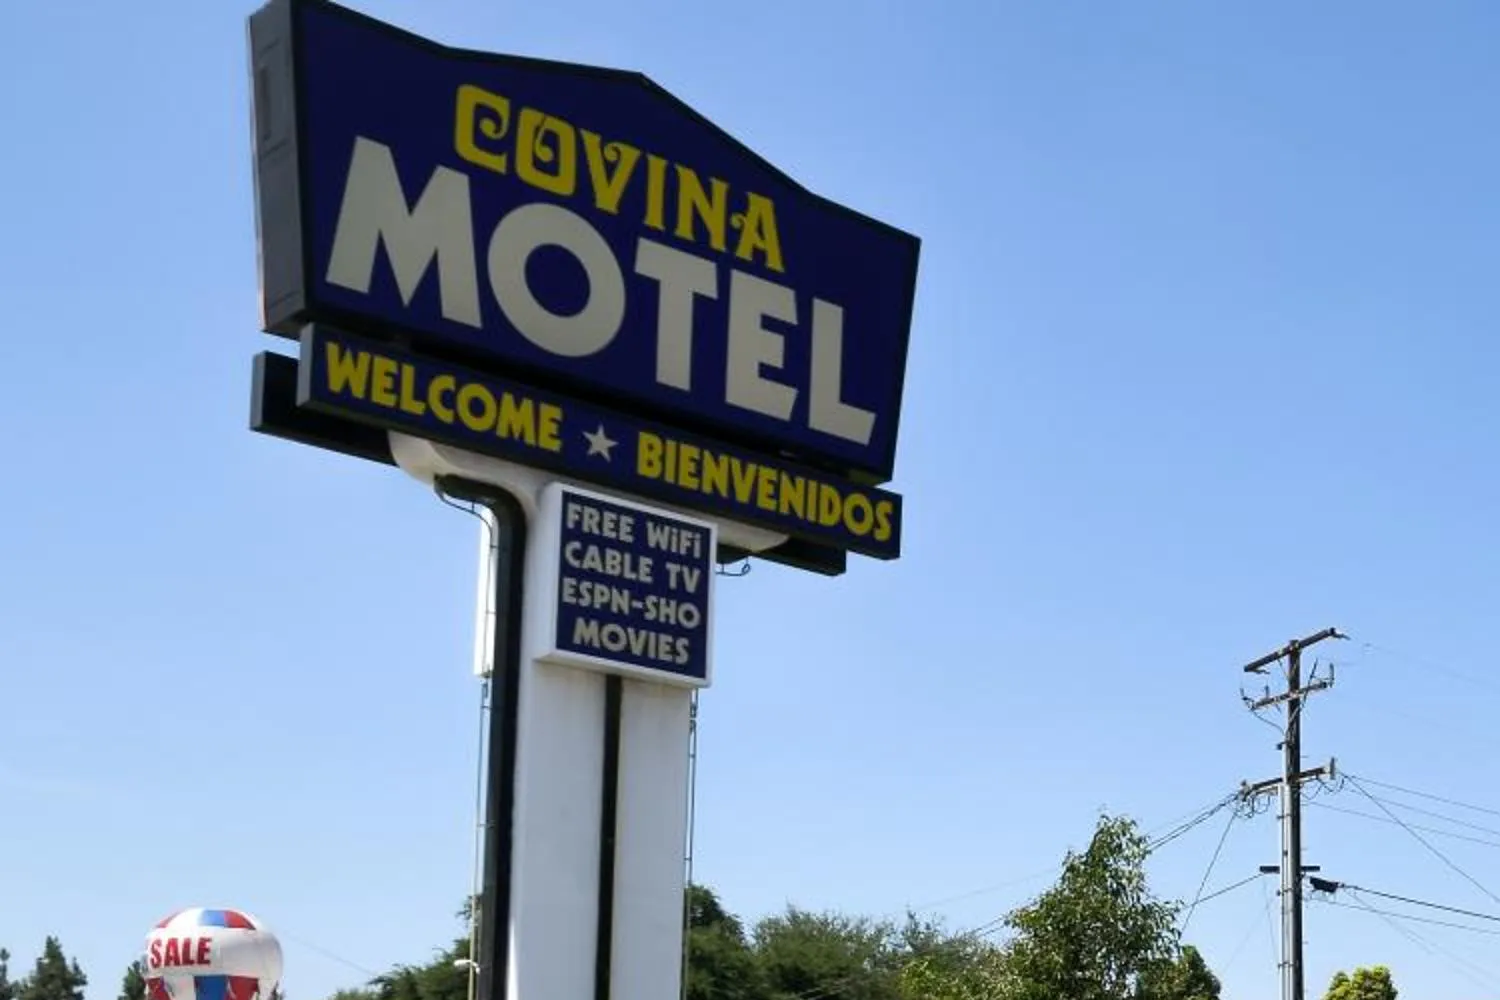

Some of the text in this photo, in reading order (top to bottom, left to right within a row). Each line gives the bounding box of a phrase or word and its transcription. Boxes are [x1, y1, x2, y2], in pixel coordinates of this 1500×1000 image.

[454, 83, 786, 274] COVINA
[325, 135, 878, 446] MOTEL
[326, 341, 892, 542] WELCOME BIENVENIDOS
[567, 502, 701, 558] FREE WiFi
[564, 541, 701, 593] CABLE TV
[562, 577, 701, 629] ESPN-SHO
[573, 617, 689, 665] MOVIES
[150, 937, 212, 968] SALE
